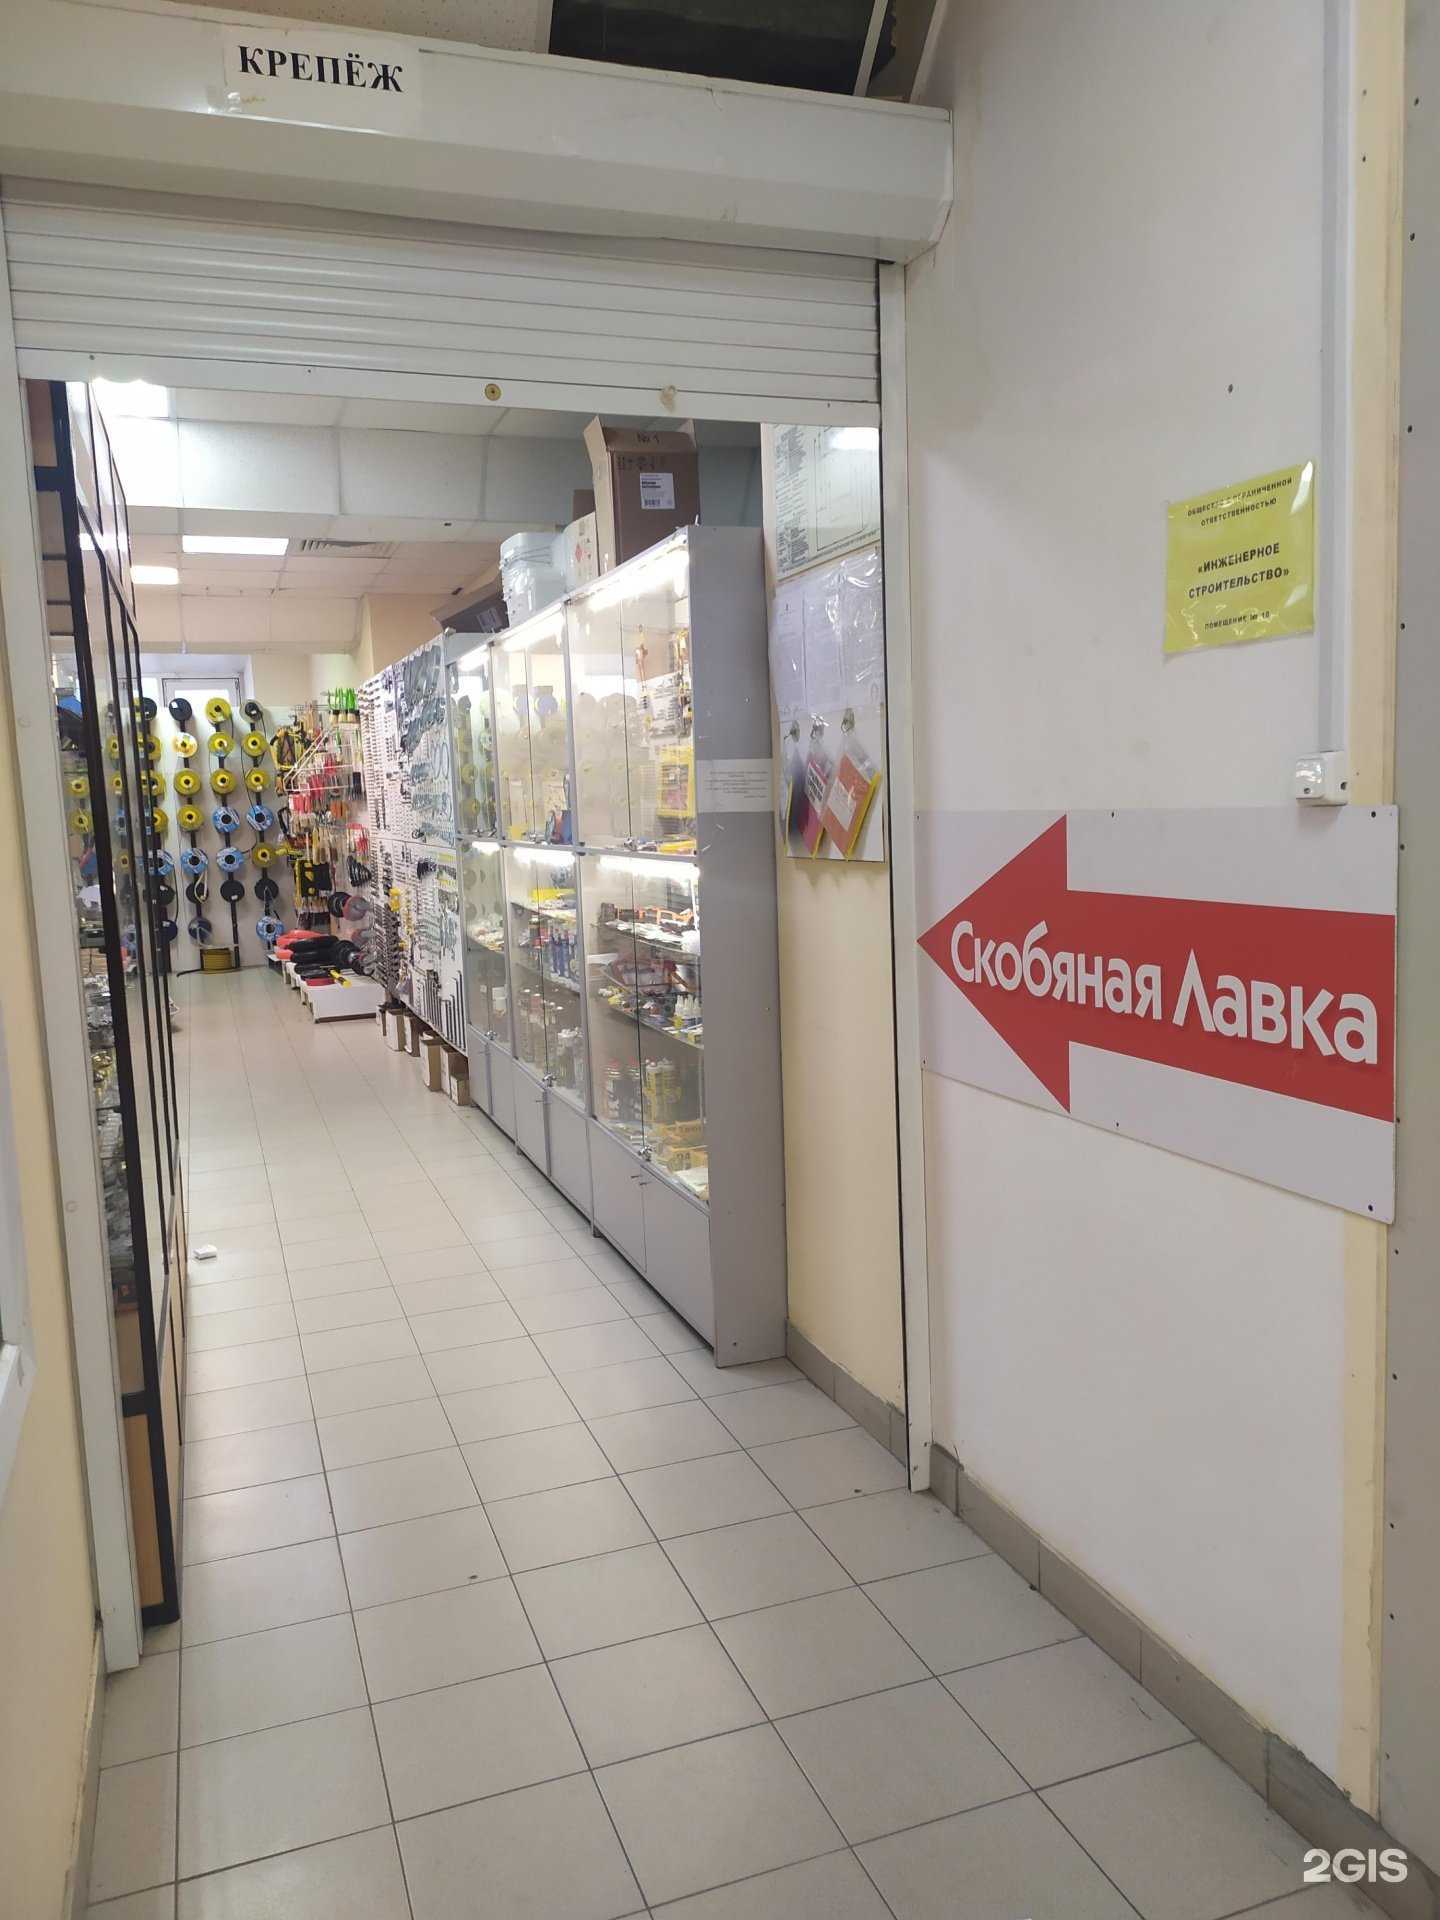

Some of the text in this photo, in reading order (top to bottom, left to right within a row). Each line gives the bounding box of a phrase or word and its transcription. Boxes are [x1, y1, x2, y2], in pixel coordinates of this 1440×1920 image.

[237, 45, 404, 93] КРЕПЁЖ
[1200, 497, 1277, 527] ОТВЕТСТВЕННОСТЬЮ
[1198, 542, 1280, 574] «ИНЖЕНЕРНОЕ
[1188, 567, 1290, 599] СТРОИТЕЛЬСТВО»
[950, 919, 1379, 1066] Скобяная Лавка
